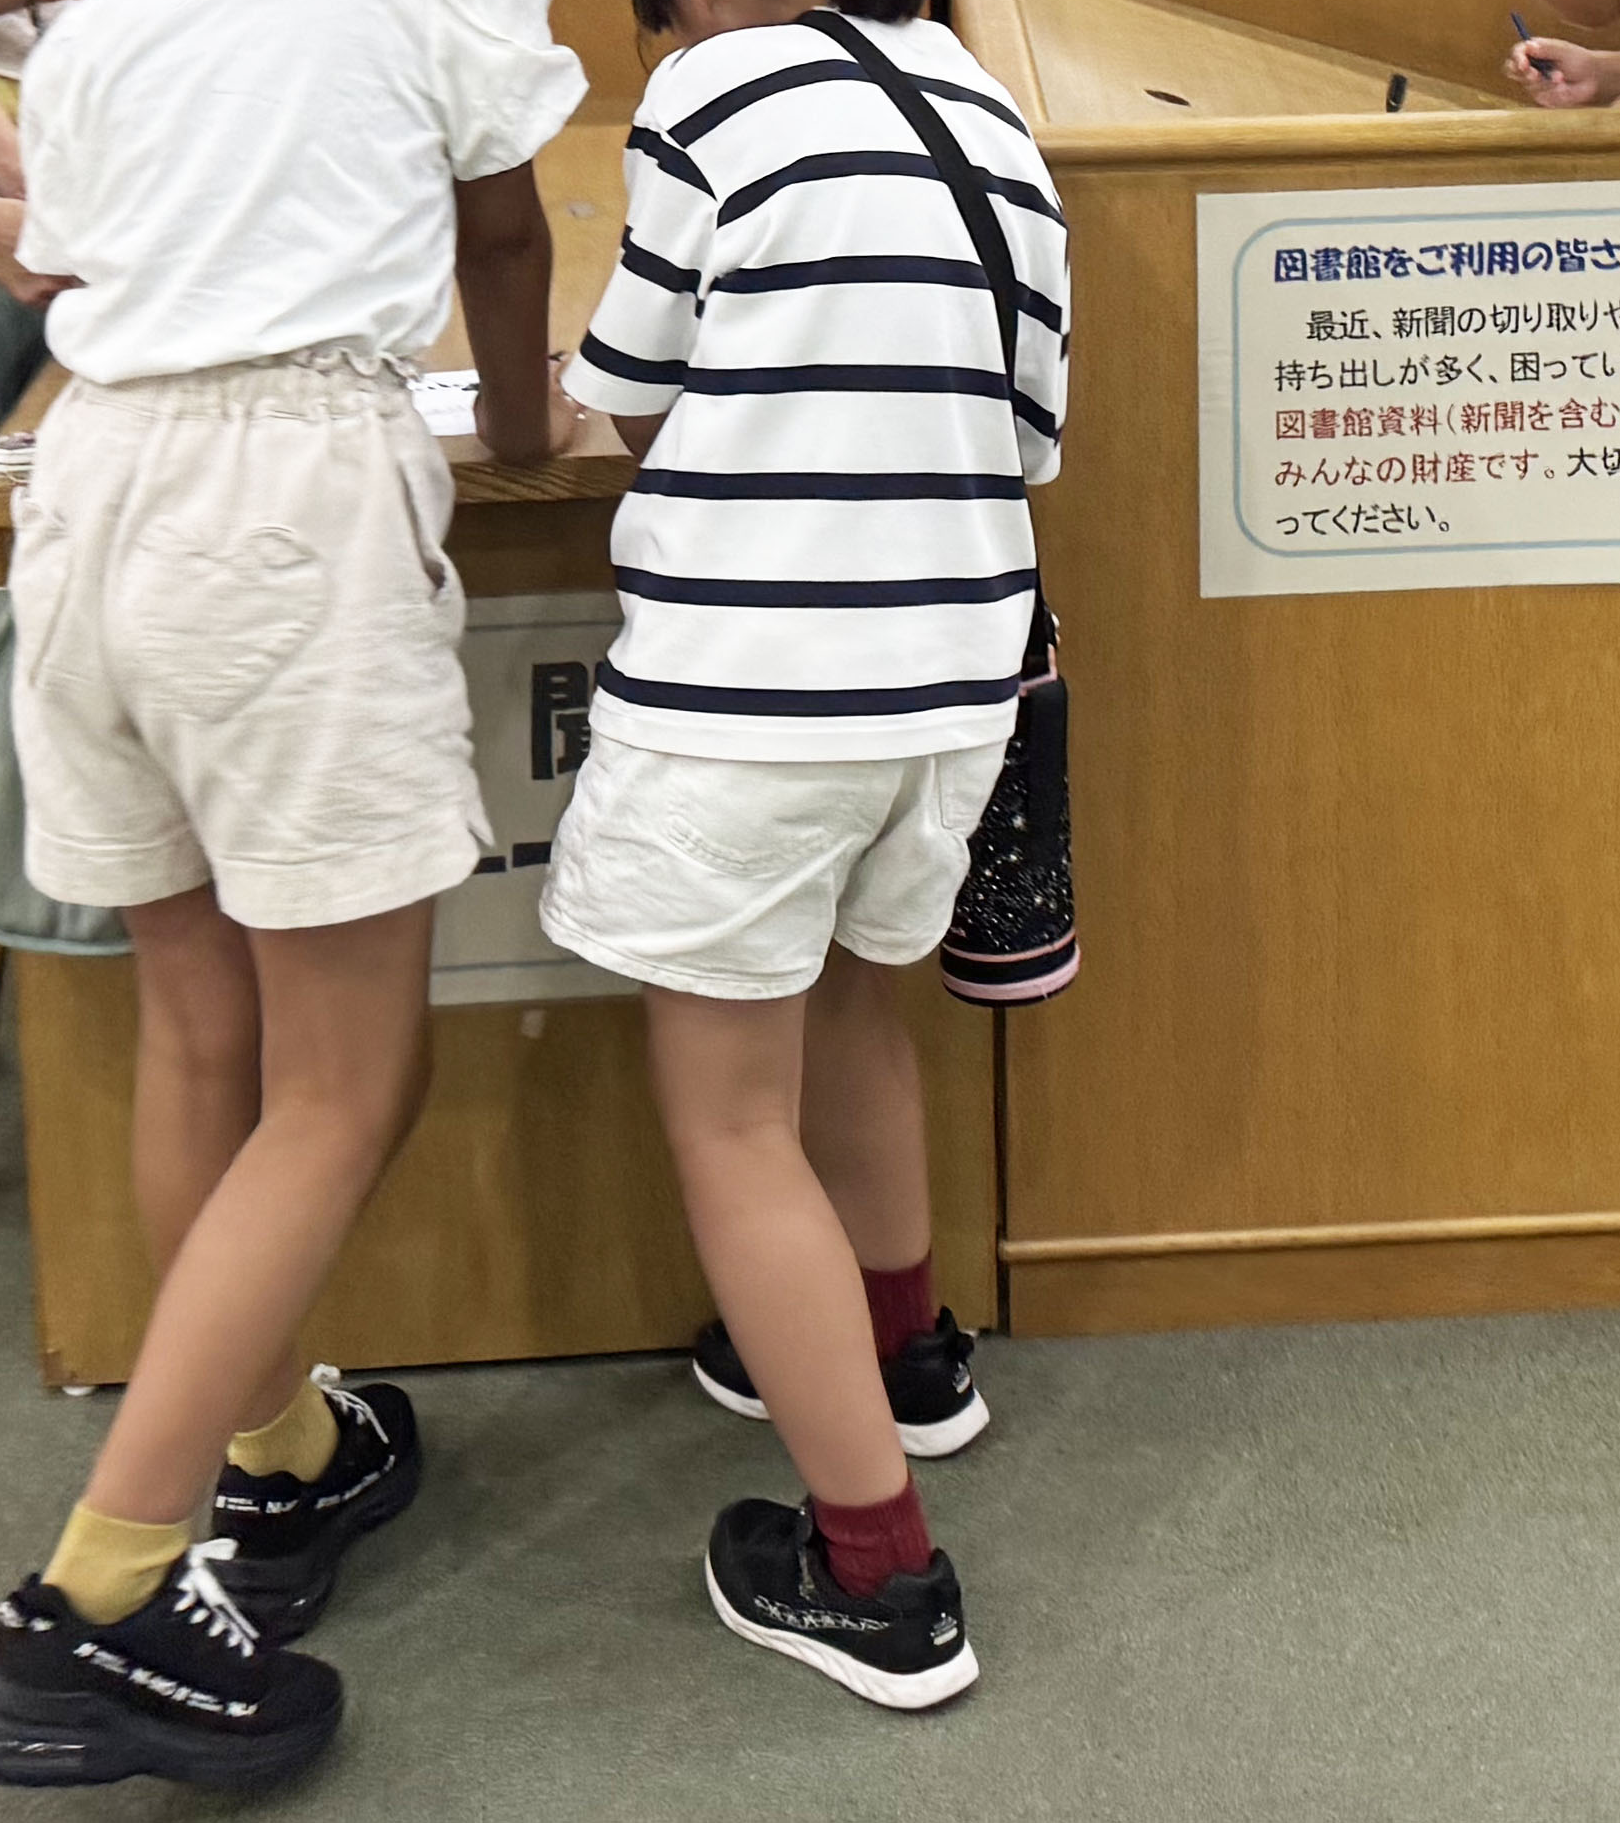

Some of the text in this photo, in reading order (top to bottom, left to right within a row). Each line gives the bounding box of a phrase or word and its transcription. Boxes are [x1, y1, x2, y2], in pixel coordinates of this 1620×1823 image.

[1275, 502, 1450, 536] ってください。
